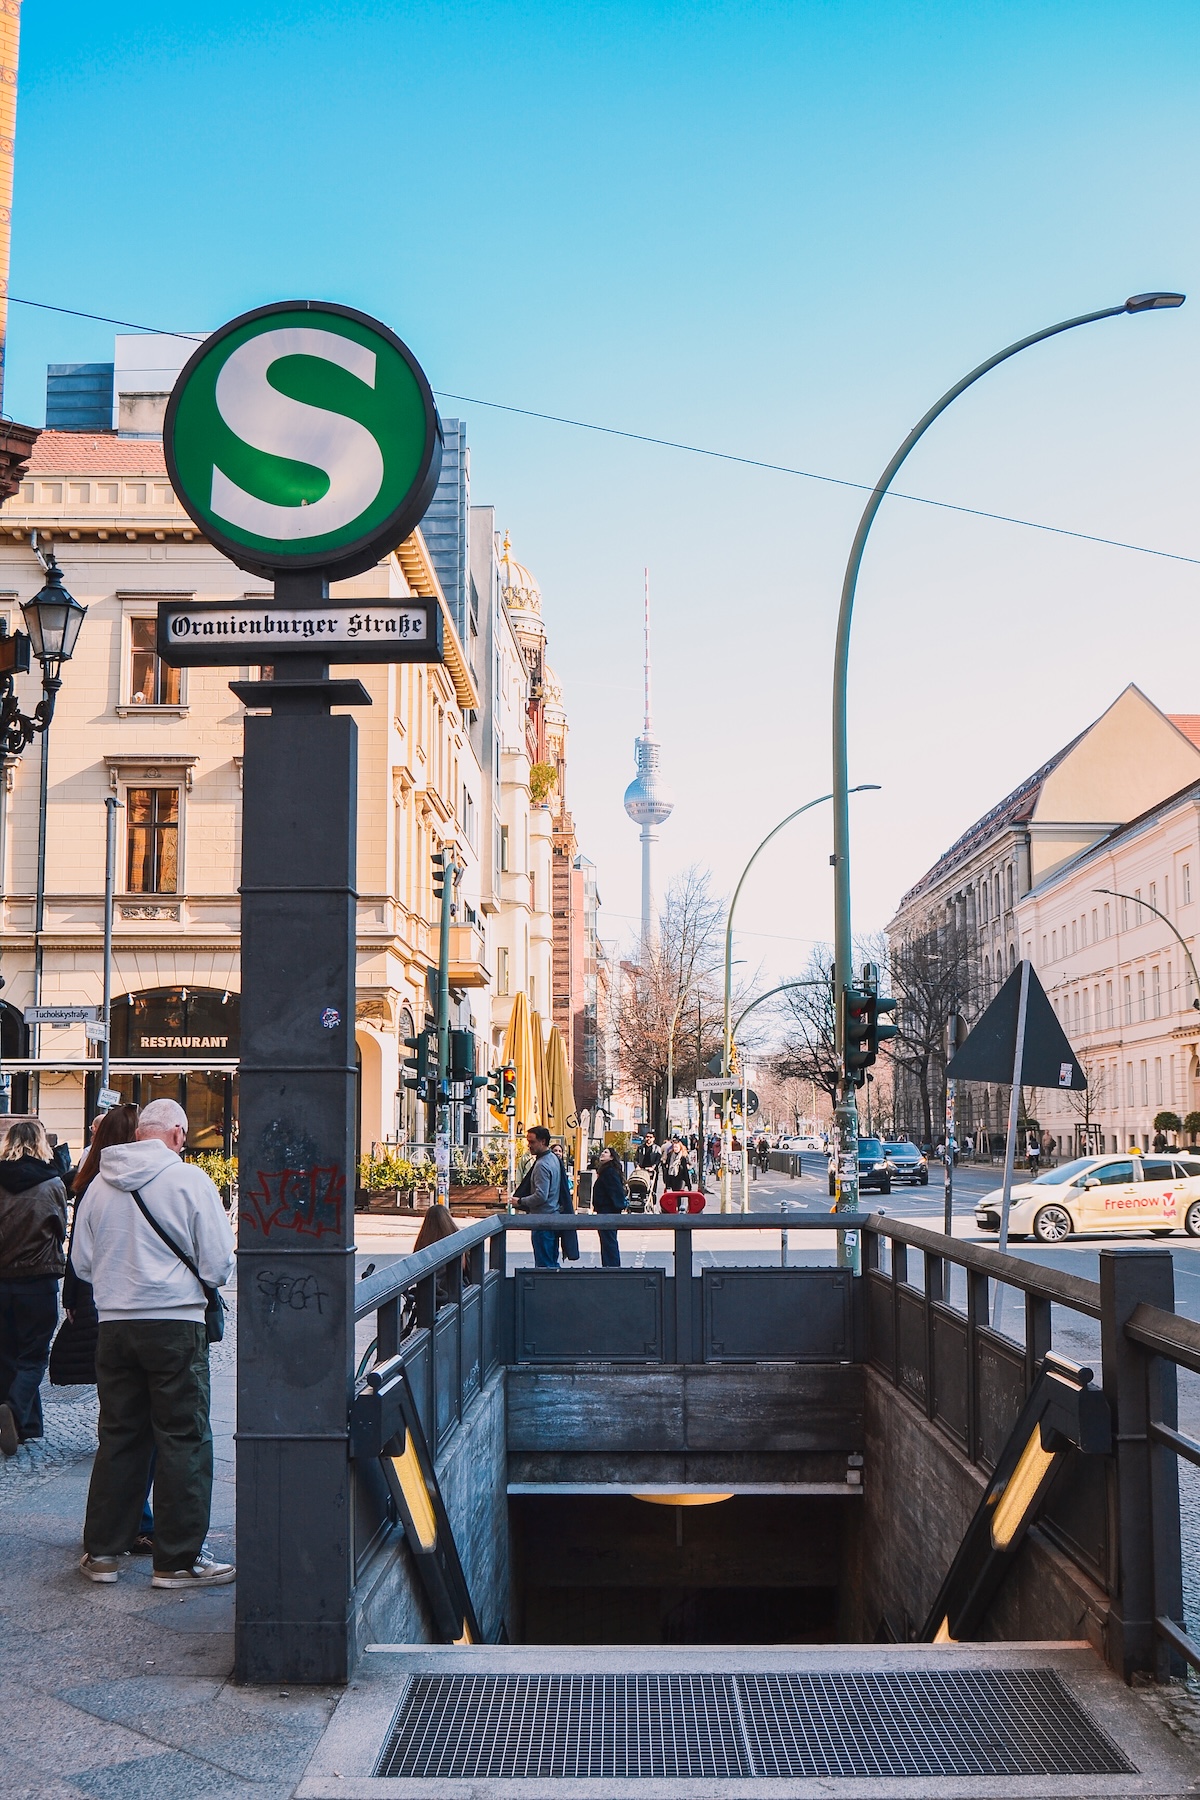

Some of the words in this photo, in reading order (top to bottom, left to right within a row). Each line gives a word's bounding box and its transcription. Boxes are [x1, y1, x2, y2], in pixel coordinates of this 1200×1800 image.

[210, 328, 384, 540] S
[171, 614, 339, 638] Oranienburger
[346, 613, 423, 638] Straße
[35, 1009, 89, 1020] Tucholskystraße
[140, 1036, 229, 1048] RESTAURANT
[1105, 1197, 1160, 1210] freenow
[1163, 1208, 1177, 1219] lyft
